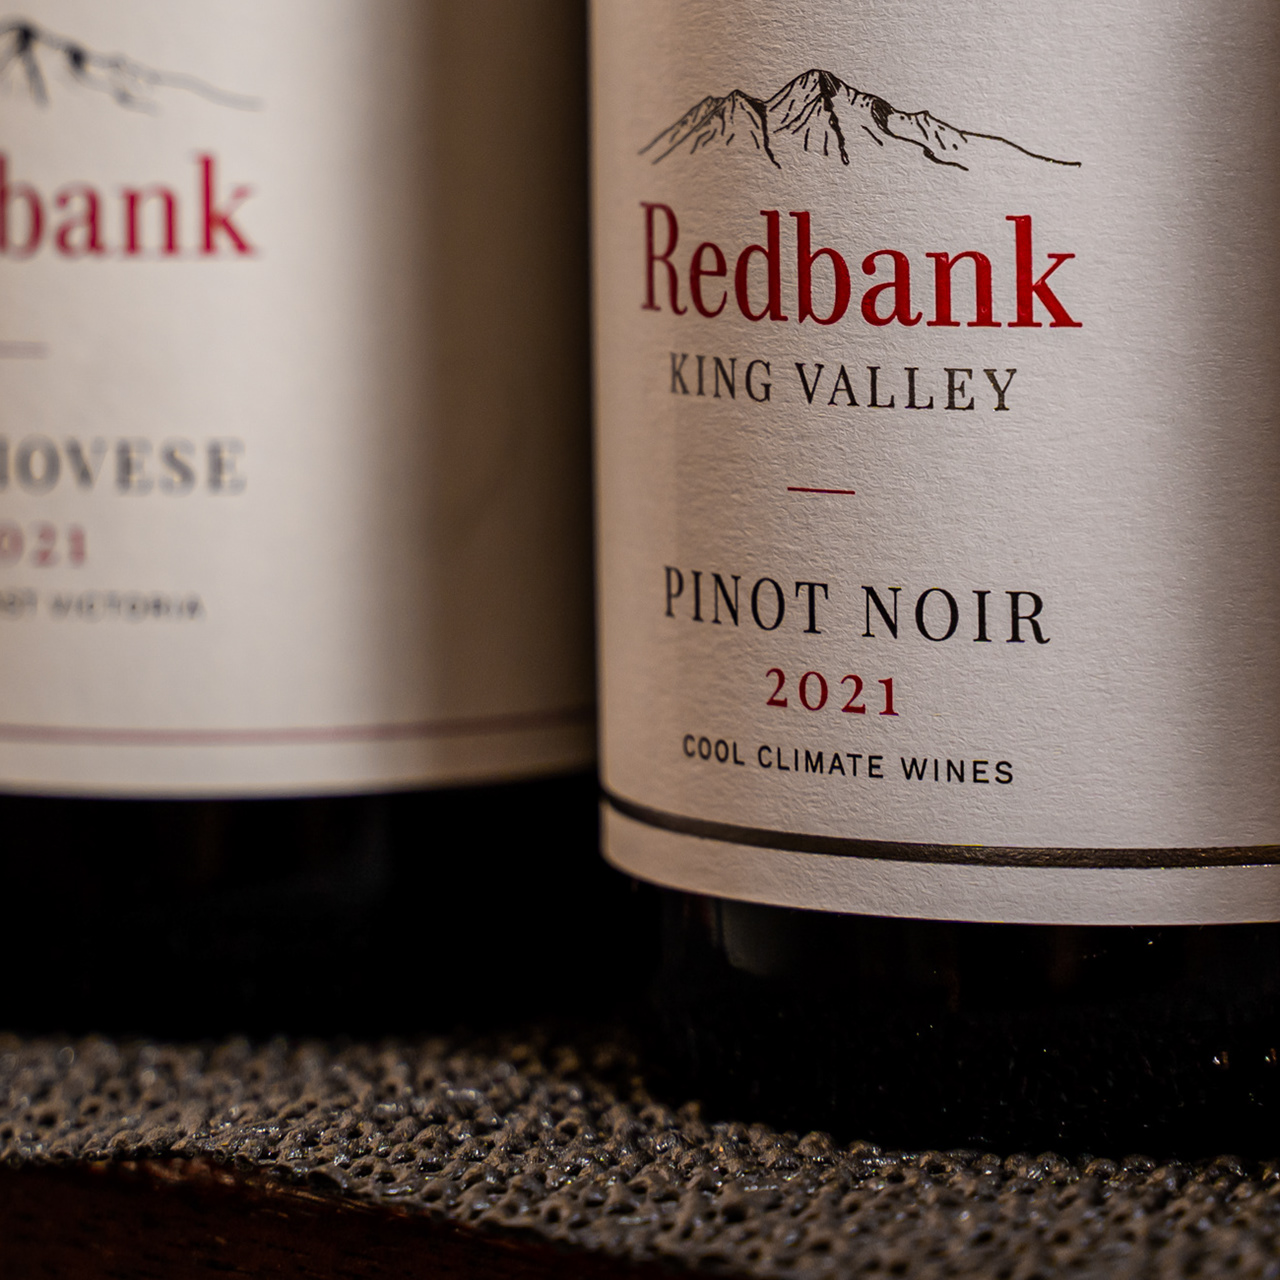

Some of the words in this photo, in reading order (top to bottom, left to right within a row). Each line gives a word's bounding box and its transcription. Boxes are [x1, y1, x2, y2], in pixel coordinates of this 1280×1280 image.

[639, 201, 1083, 328] Redbank
[669, 351, 773, 403] KING
[794, 361, 1018, 411] VALLEY
[663, 565, 829, 635] PINOT
[861, 584, 1051, 645] NOIR
[765, 666, 900, 717] 2021
[682, 733, 745, 766] COOL
[757, 744, 885, 779] CLIMATE
[900, 756, 1015, 786] WINES
